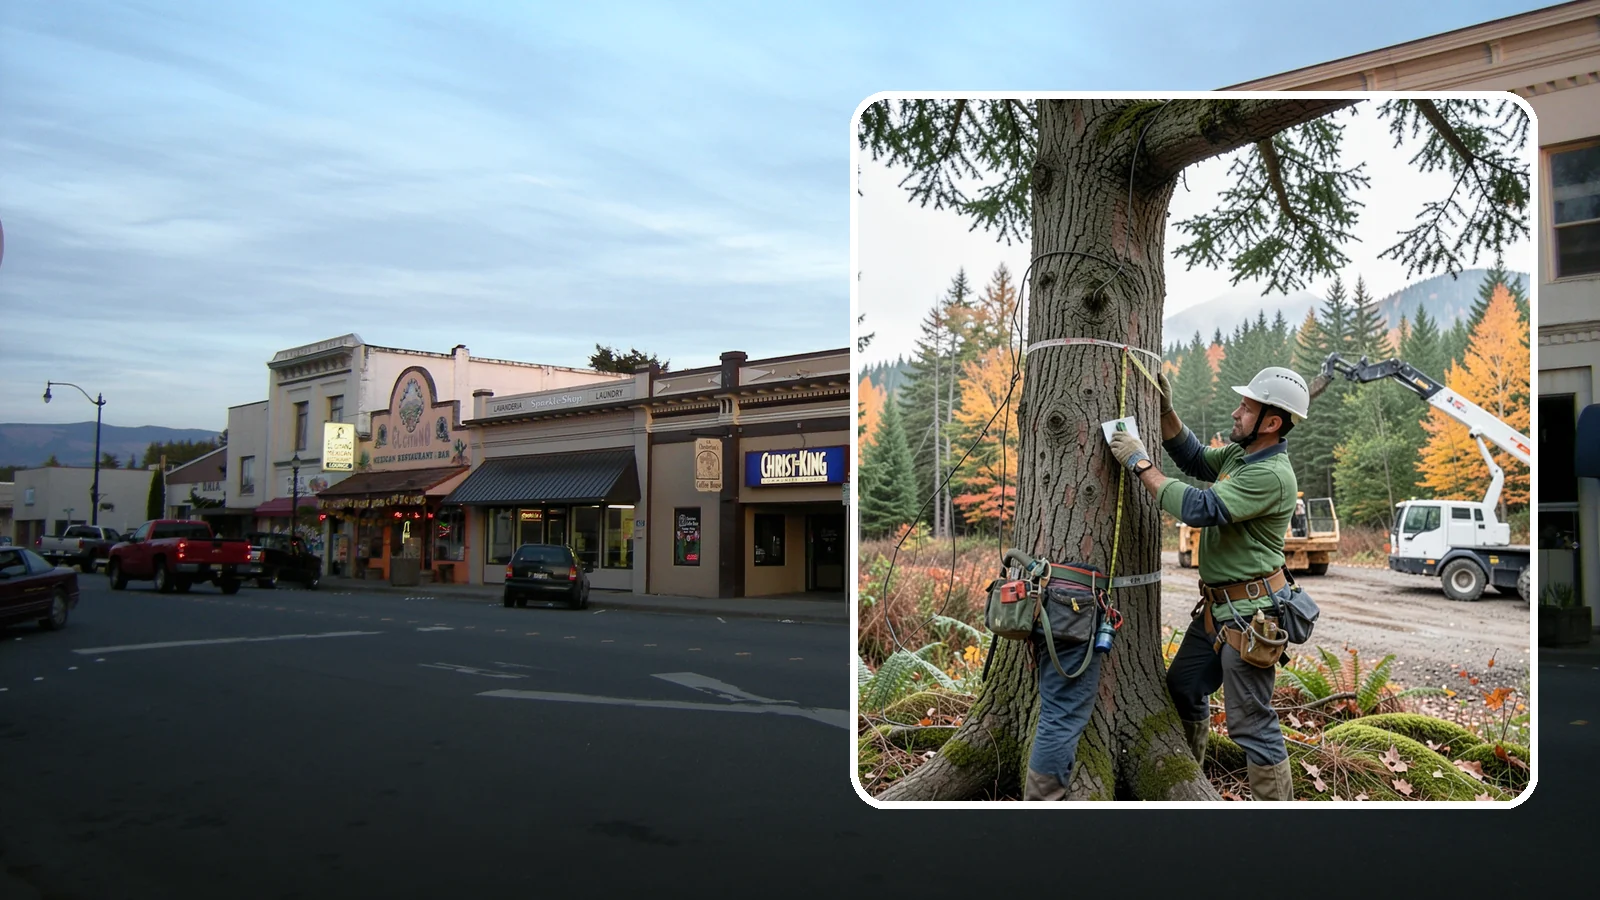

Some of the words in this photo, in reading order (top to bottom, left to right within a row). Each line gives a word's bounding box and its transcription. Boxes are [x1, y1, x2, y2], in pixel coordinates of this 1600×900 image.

[493, 402, 522, 413] LAVANDERIA
[561, 395, 583, 404] Shop
[595, 389, 623, 400] LAUNDRY
[373, 455, 396, 464] MEXICAN
[397, 451, 433, 462] RESTAURANT
[437, 450, 450, 459] BAR
[761, 452, 797, 478] CHRIST
[799, 450, 827, 476] KING
